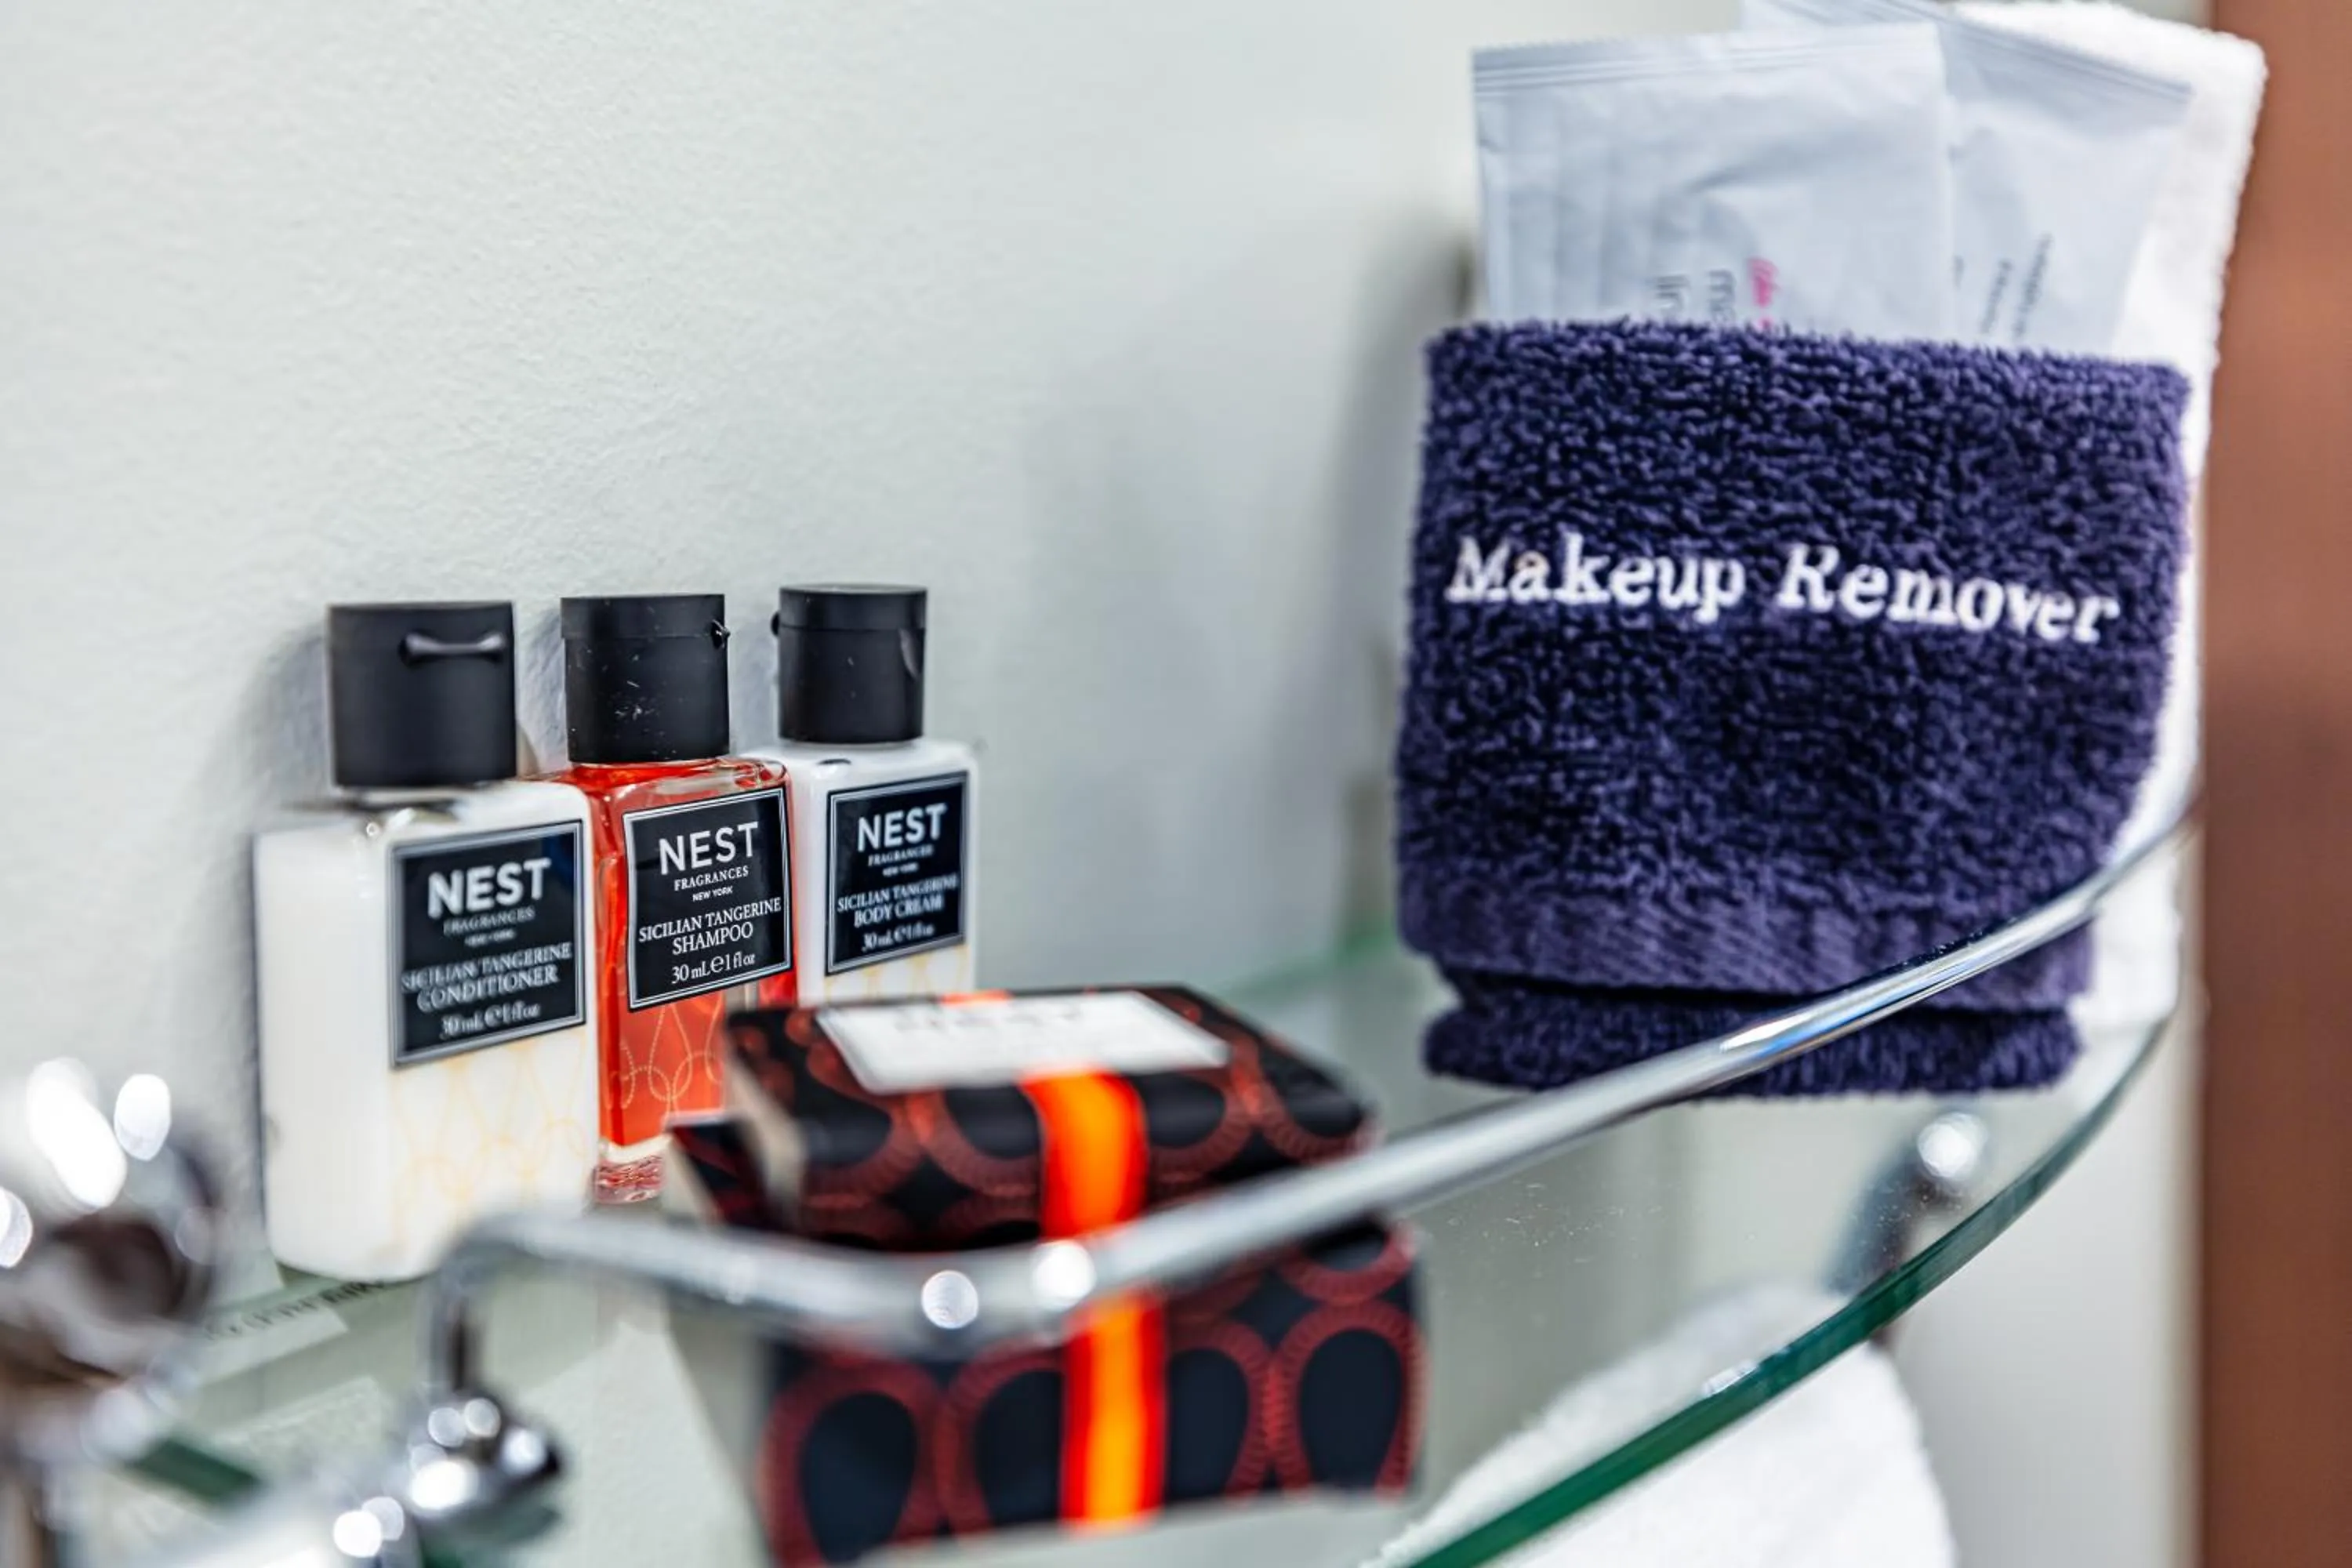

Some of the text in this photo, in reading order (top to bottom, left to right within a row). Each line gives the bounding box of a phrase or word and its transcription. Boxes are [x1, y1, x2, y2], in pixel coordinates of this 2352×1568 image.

[1446, 533, 2121, 644] Makeup Remover
[659, 822, 759, 876] NEST
[858, 802, 947, 853] NEST
[427, 858, 551, 920] NEST
[673, 866, 750, 891] FRAGRANCES
[692, 885, 734, 902] NEW YORK
[837, 889, 891, 913] SICILIAN
[638, 897, 782, 942] SICILIAN TANGERINE
[854, 893, 946, 929] BODY CREAM
[672, 921, 753, 956] SHAMPOO
[401, 942, 572, 993] SICILIAN TANGERINE
[416, 964, 560, 1013] CONDITIONER
[671, 964, 690, 985] 30
